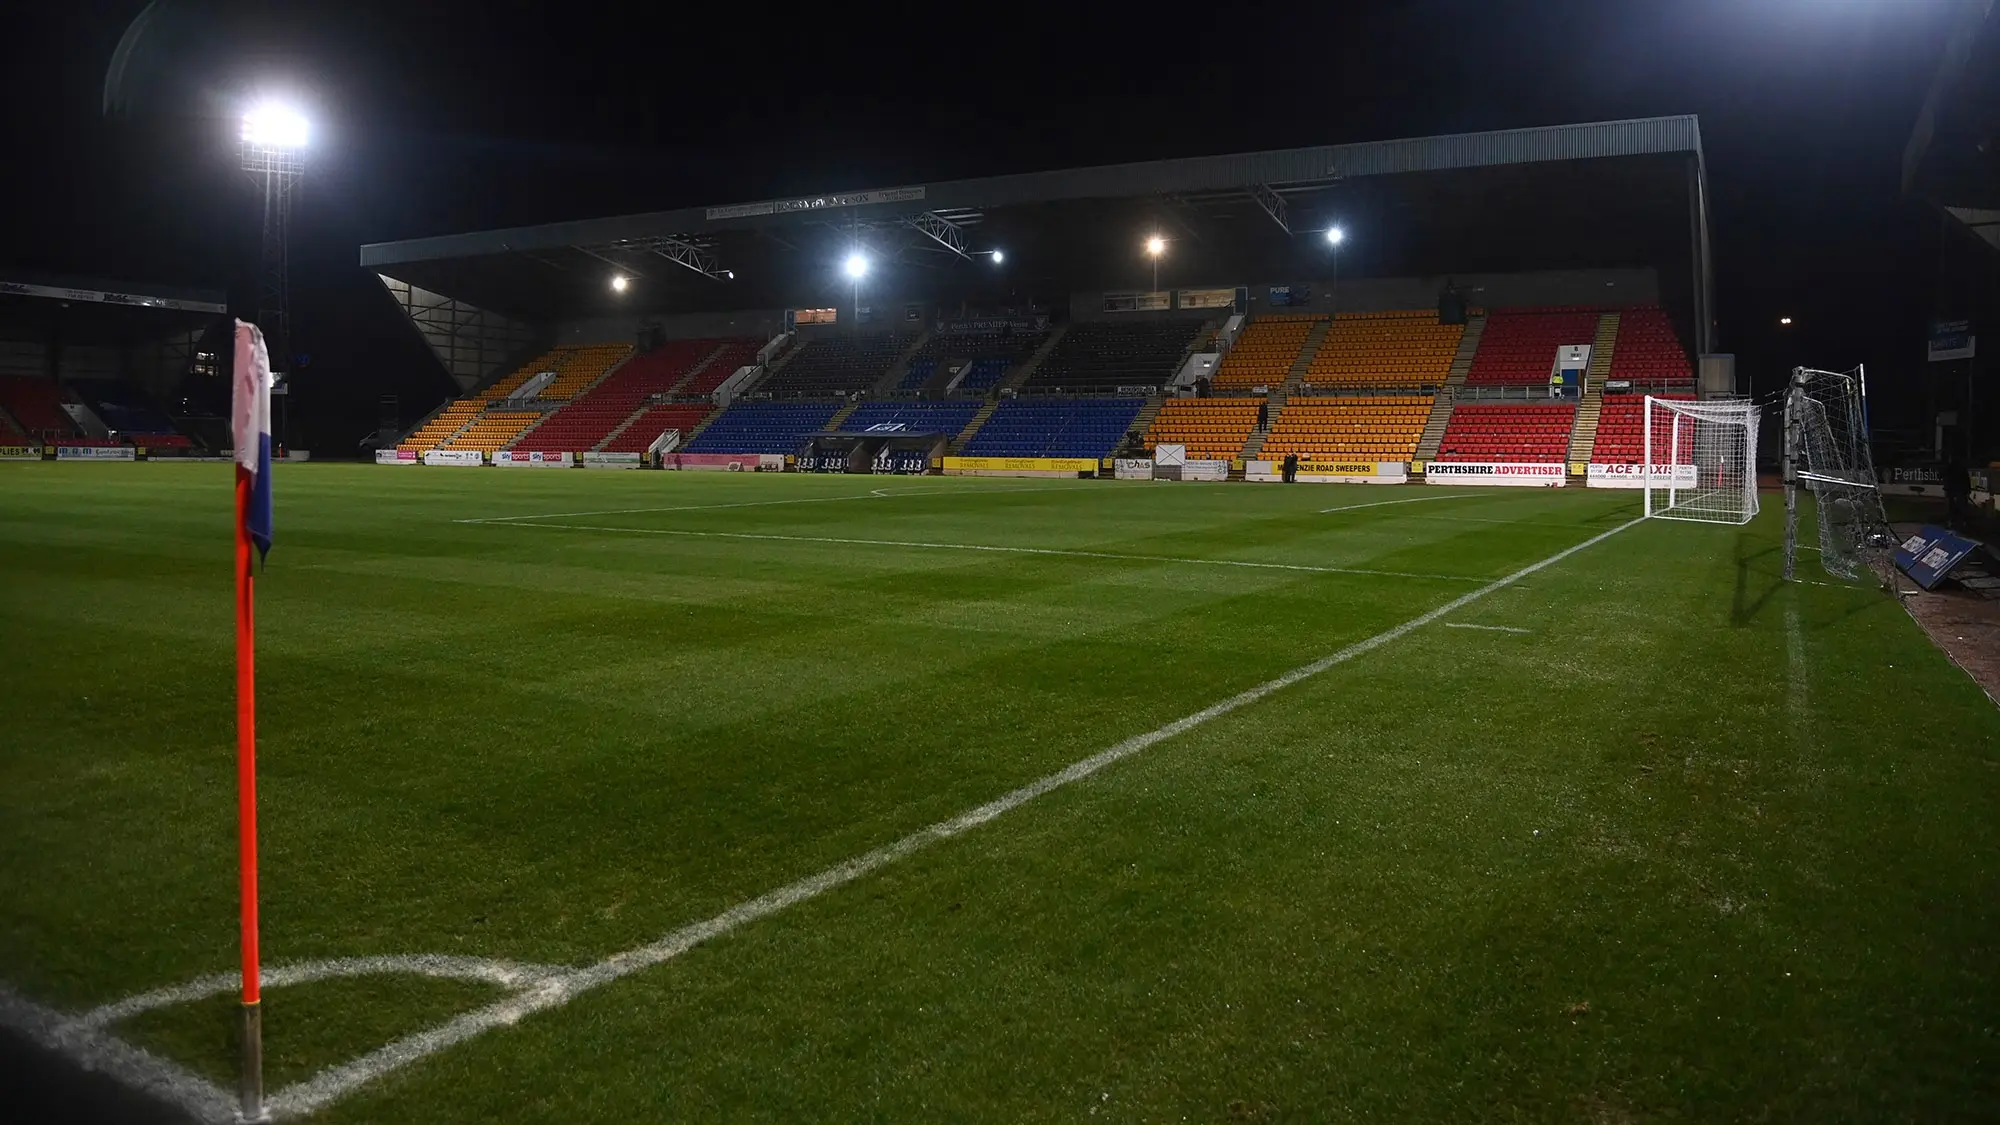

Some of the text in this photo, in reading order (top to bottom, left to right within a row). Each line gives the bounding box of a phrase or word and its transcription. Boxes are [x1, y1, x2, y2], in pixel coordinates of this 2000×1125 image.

[1277, 464, 1371, 472] MENZIE ROAD SWEEPERS
[1428, 465, 1562, 475] PERTHSHIRE ADVERTISER
[1605, 465, 1633, 474] ACE
